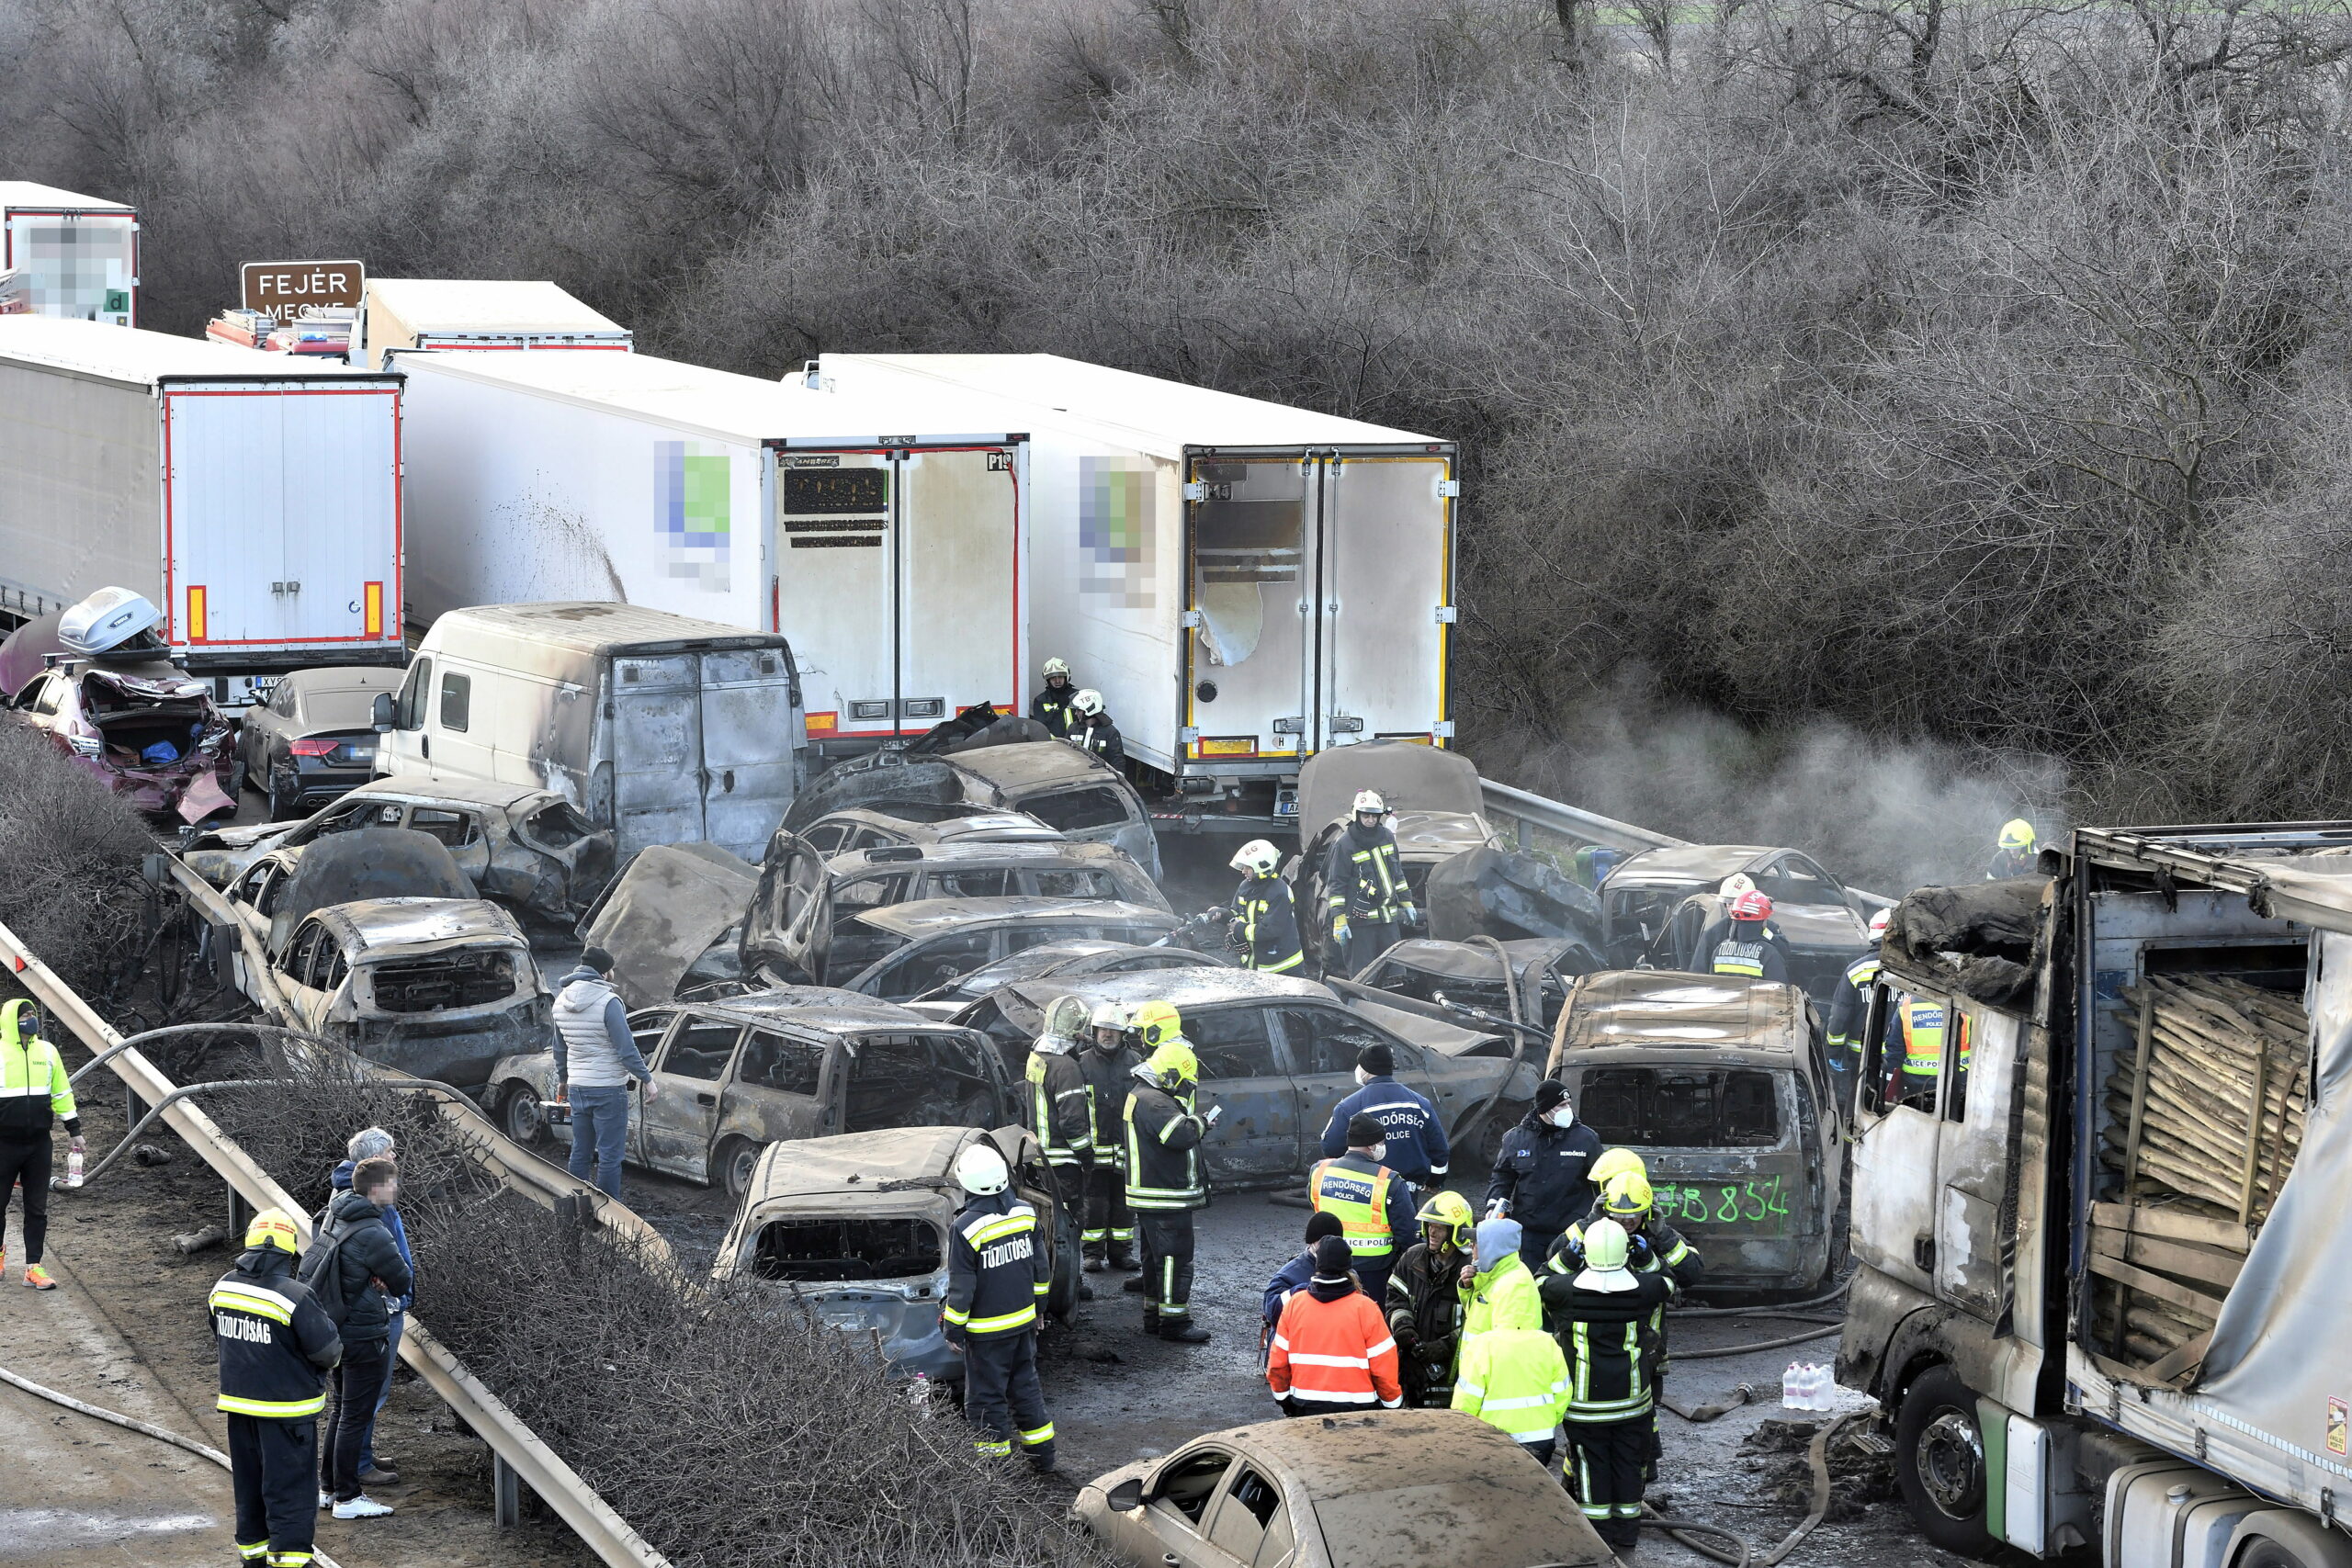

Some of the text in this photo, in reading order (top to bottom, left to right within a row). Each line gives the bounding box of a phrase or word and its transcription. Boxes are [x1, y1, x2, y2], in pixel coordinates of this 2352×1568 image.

[259, 267, 348, 295] FEJÉR
[1278, 737, 1284, 747] H
[1244, 845, 1258, 856] EG
[1734, 877, 1746, 890] EG
[1385, 1130, 1410, 1141] OLICE
[1323, 1179, 1372, 1198] RENDŐRSÉG
[1334, 1190, 1355, 1201] POLICE
[1716, 1175, 1790, 1235] 854
[980, 1234, 1035, 1269] TŰZOLTÓSÁ
